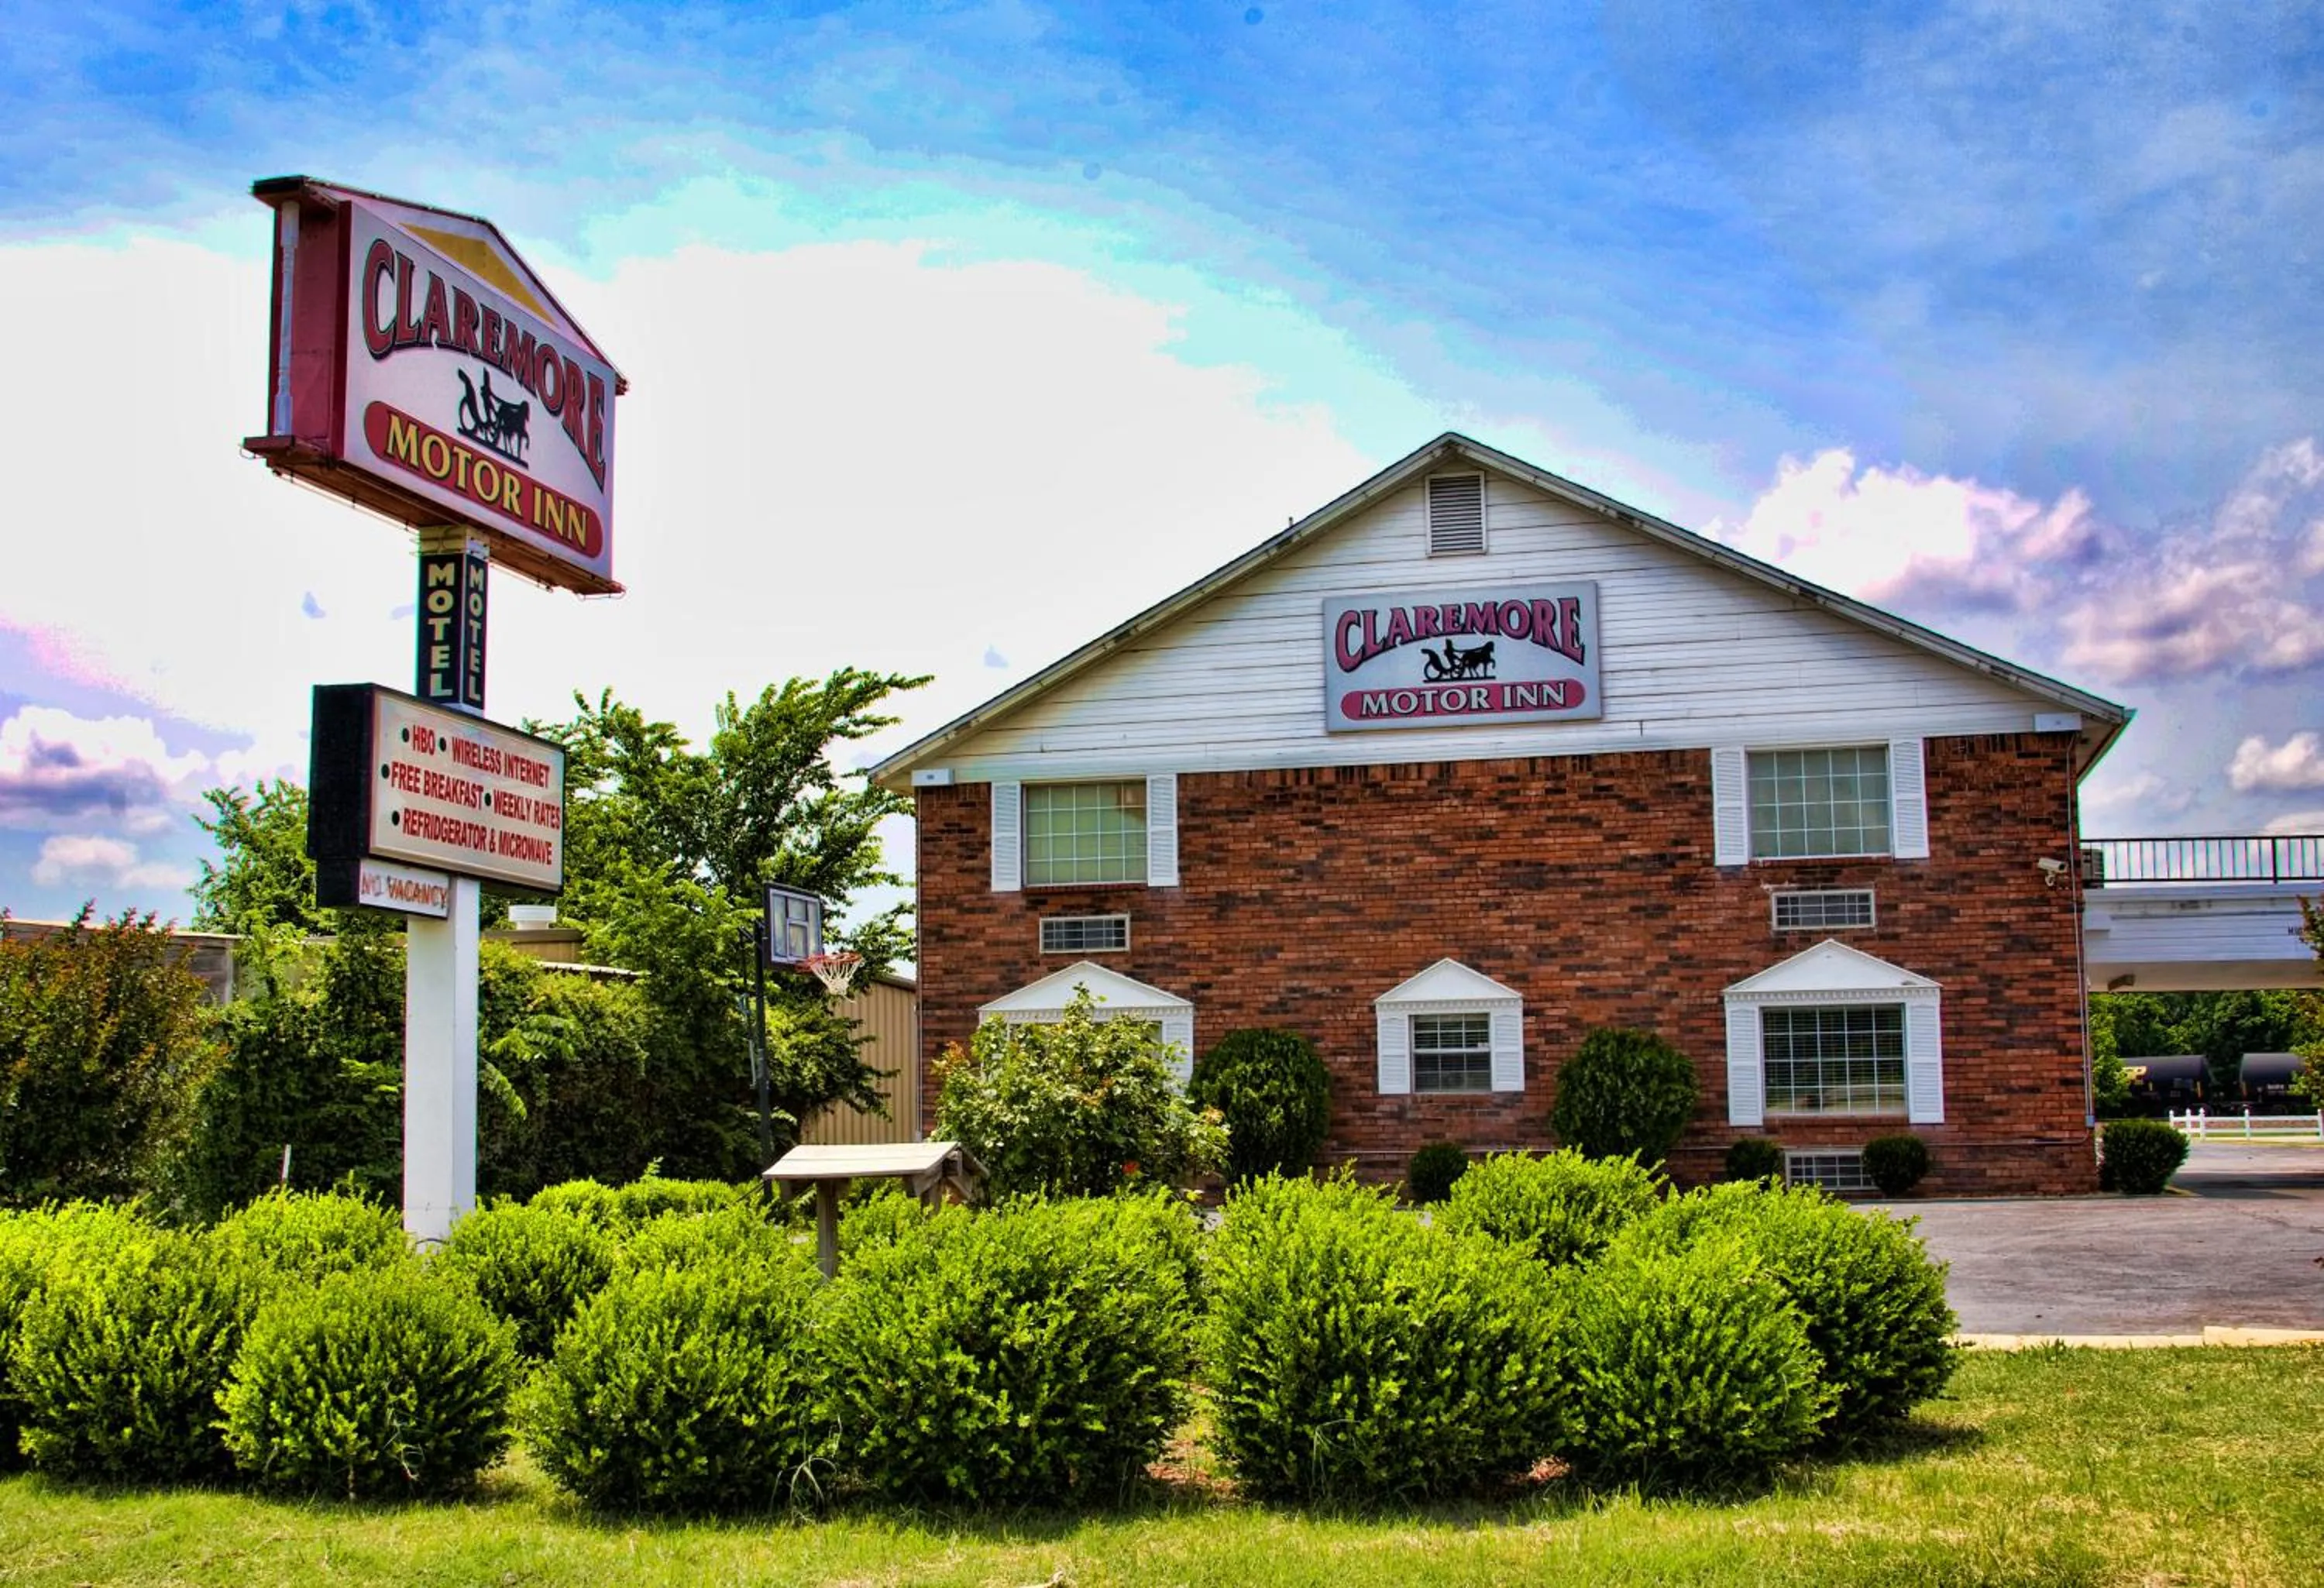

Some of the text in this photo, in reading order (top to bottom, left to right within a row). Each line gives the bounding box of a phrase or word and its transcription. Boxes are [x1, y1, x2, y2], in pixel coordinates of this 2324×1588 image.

[363, 239, 607, 493] CLAREMORE
[385, 413, 588, 548] MOTOR INN
[428, 563, 454, 697] MOTEL
[469, 565, 483, 701] MOTEL
[1335, 596, 1586, 673] CLAREMORE
[1360, 682, 1566, 718] MOTOR INN
[412, 724, 550, 789] HBO WIRELESS INTERNET
[390, 761, 561, 830] FREE BREAKFAST WEEKLY RATES
[402, 808, 552, 865] REFRIDGERATOR & MICROWAVE
[387, 875, 447, 909] VACANCY
